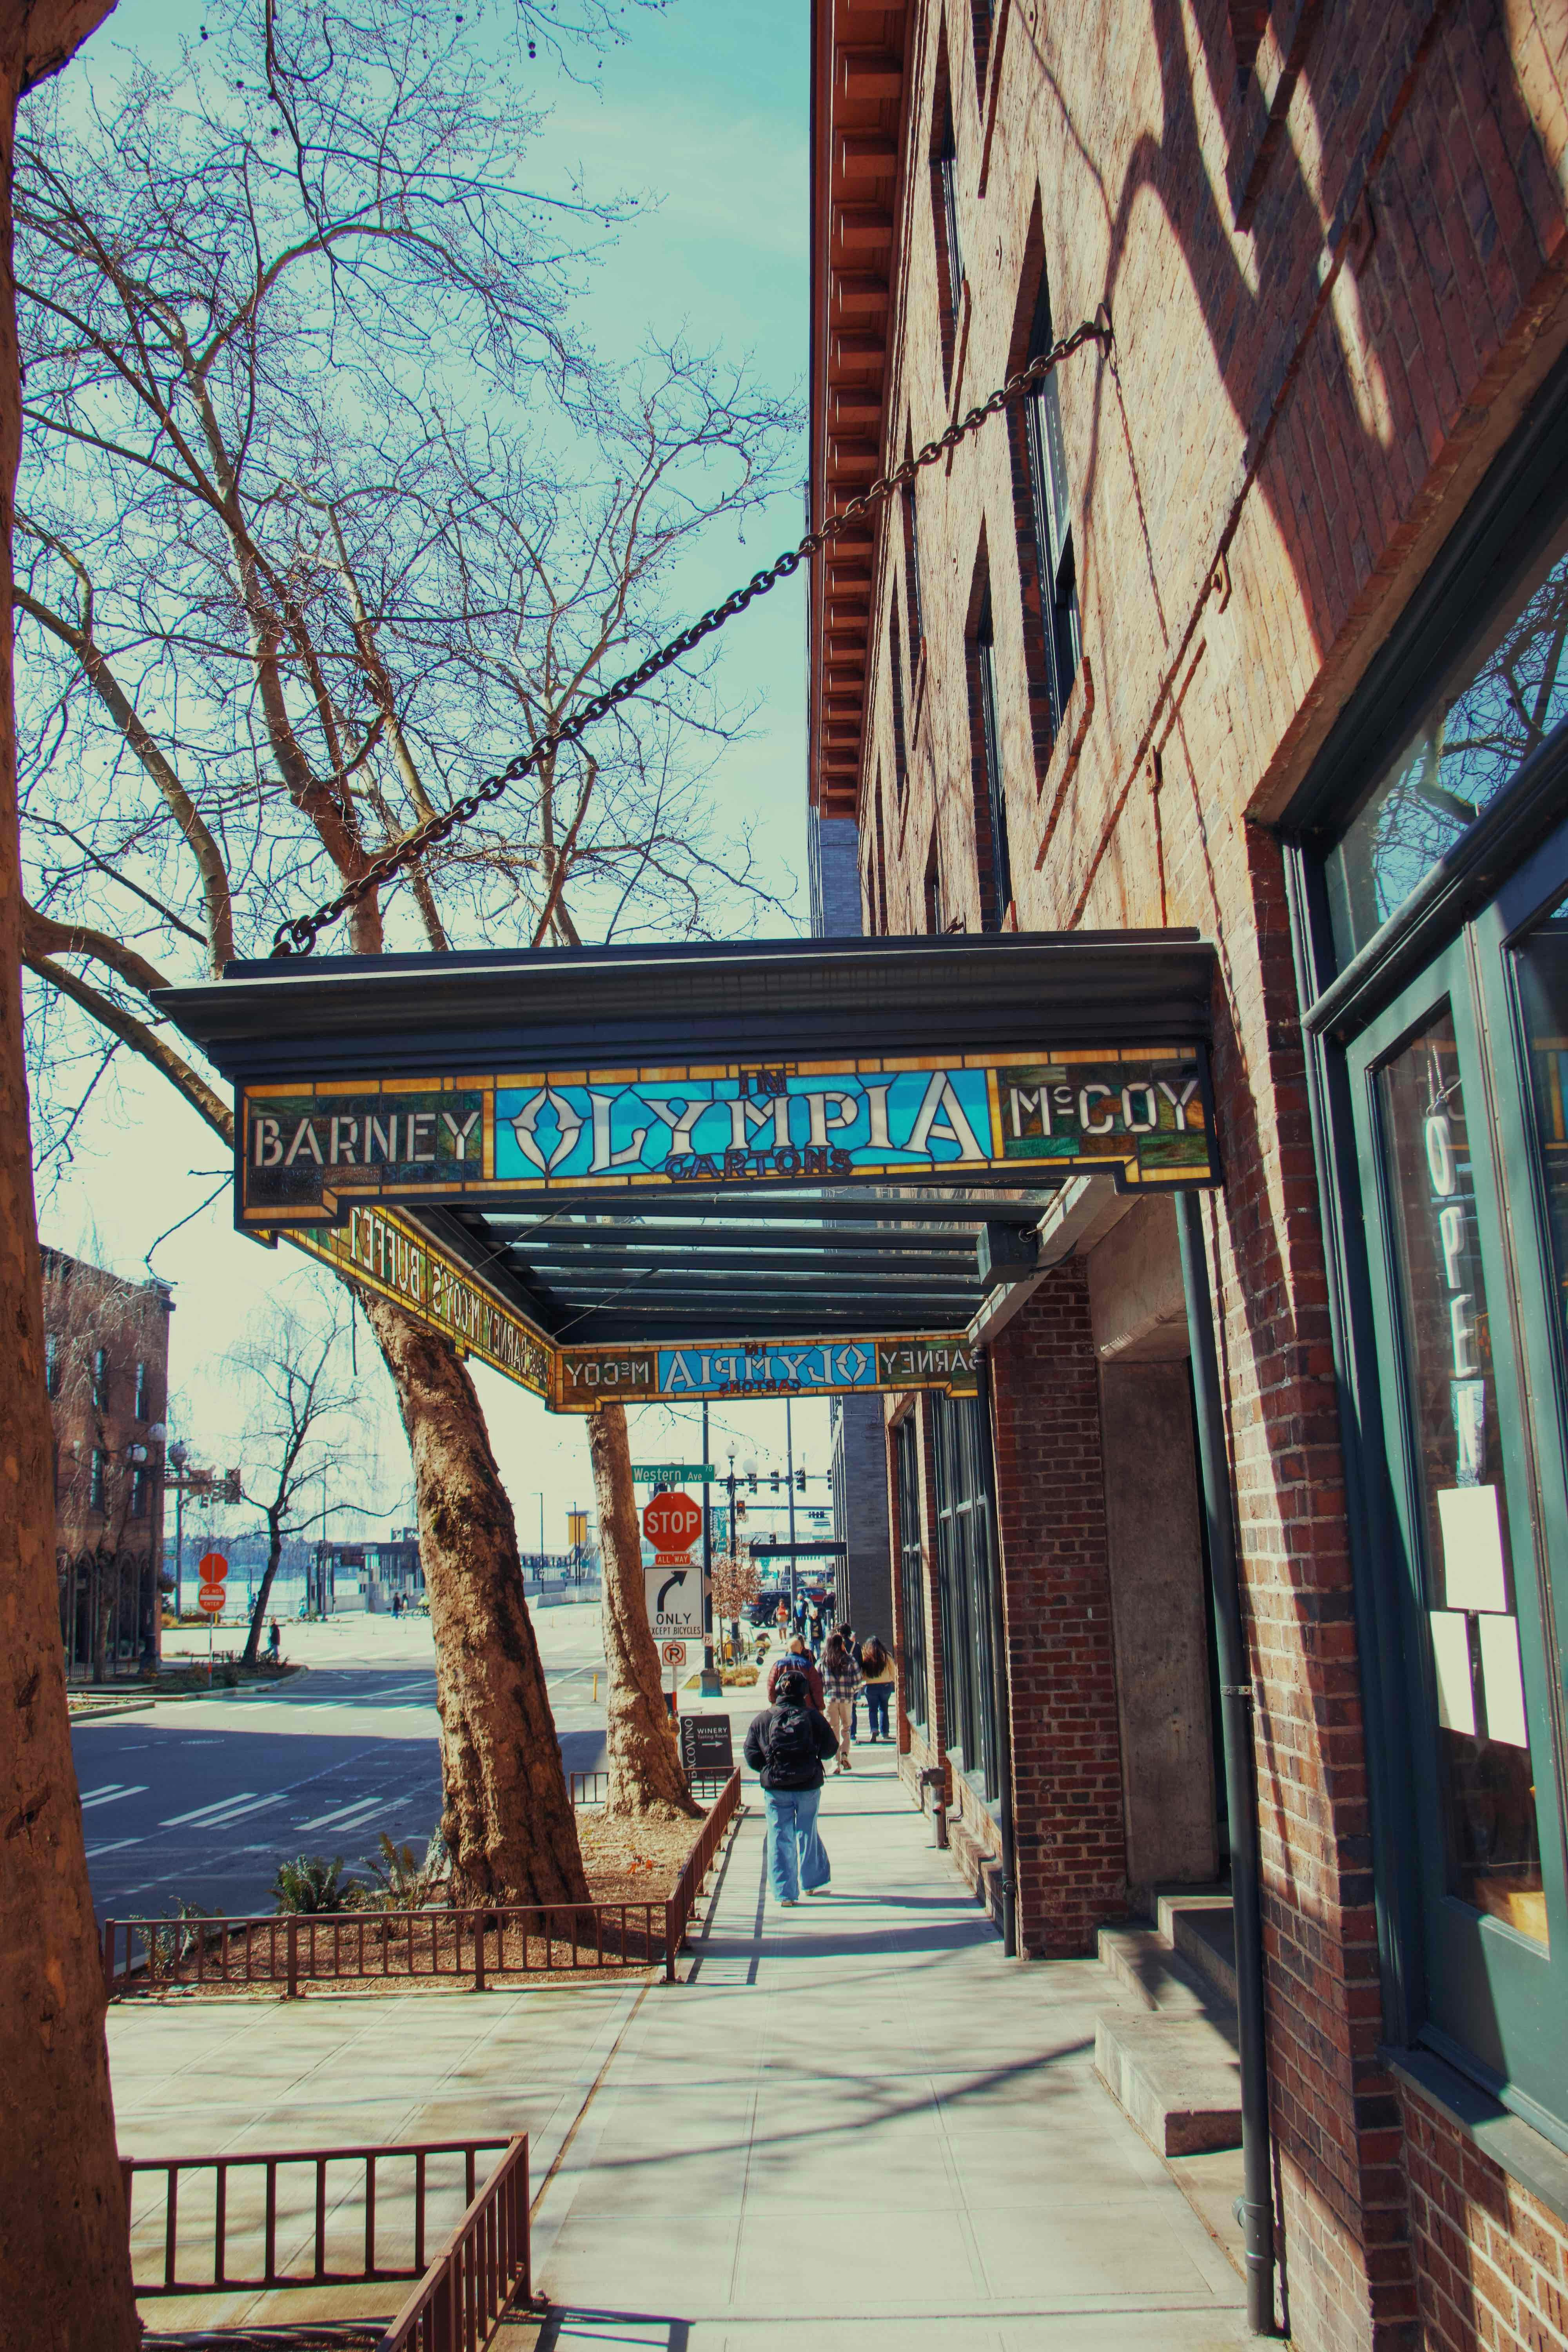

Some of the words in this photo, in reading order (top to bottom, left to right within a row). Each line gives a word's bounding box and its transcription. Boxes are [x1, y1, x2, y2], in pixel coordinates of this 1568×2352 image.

[740, 1070, 786, 1095] IN
[254, 1111, 481, 1167] BARNEY
[510, 1071, 989, 1173] OLYMPIA
[666, 1148, 853, 1180] CARTONS
[1425, 1116, 1480, 1471] OPEN
[633, 1468, 681, 1481] Western
[688, 1472, 702, 1481] Ave
[647, 1512, 699, 1534] STOP
[656, 1613, 691, 1625] ONLY
